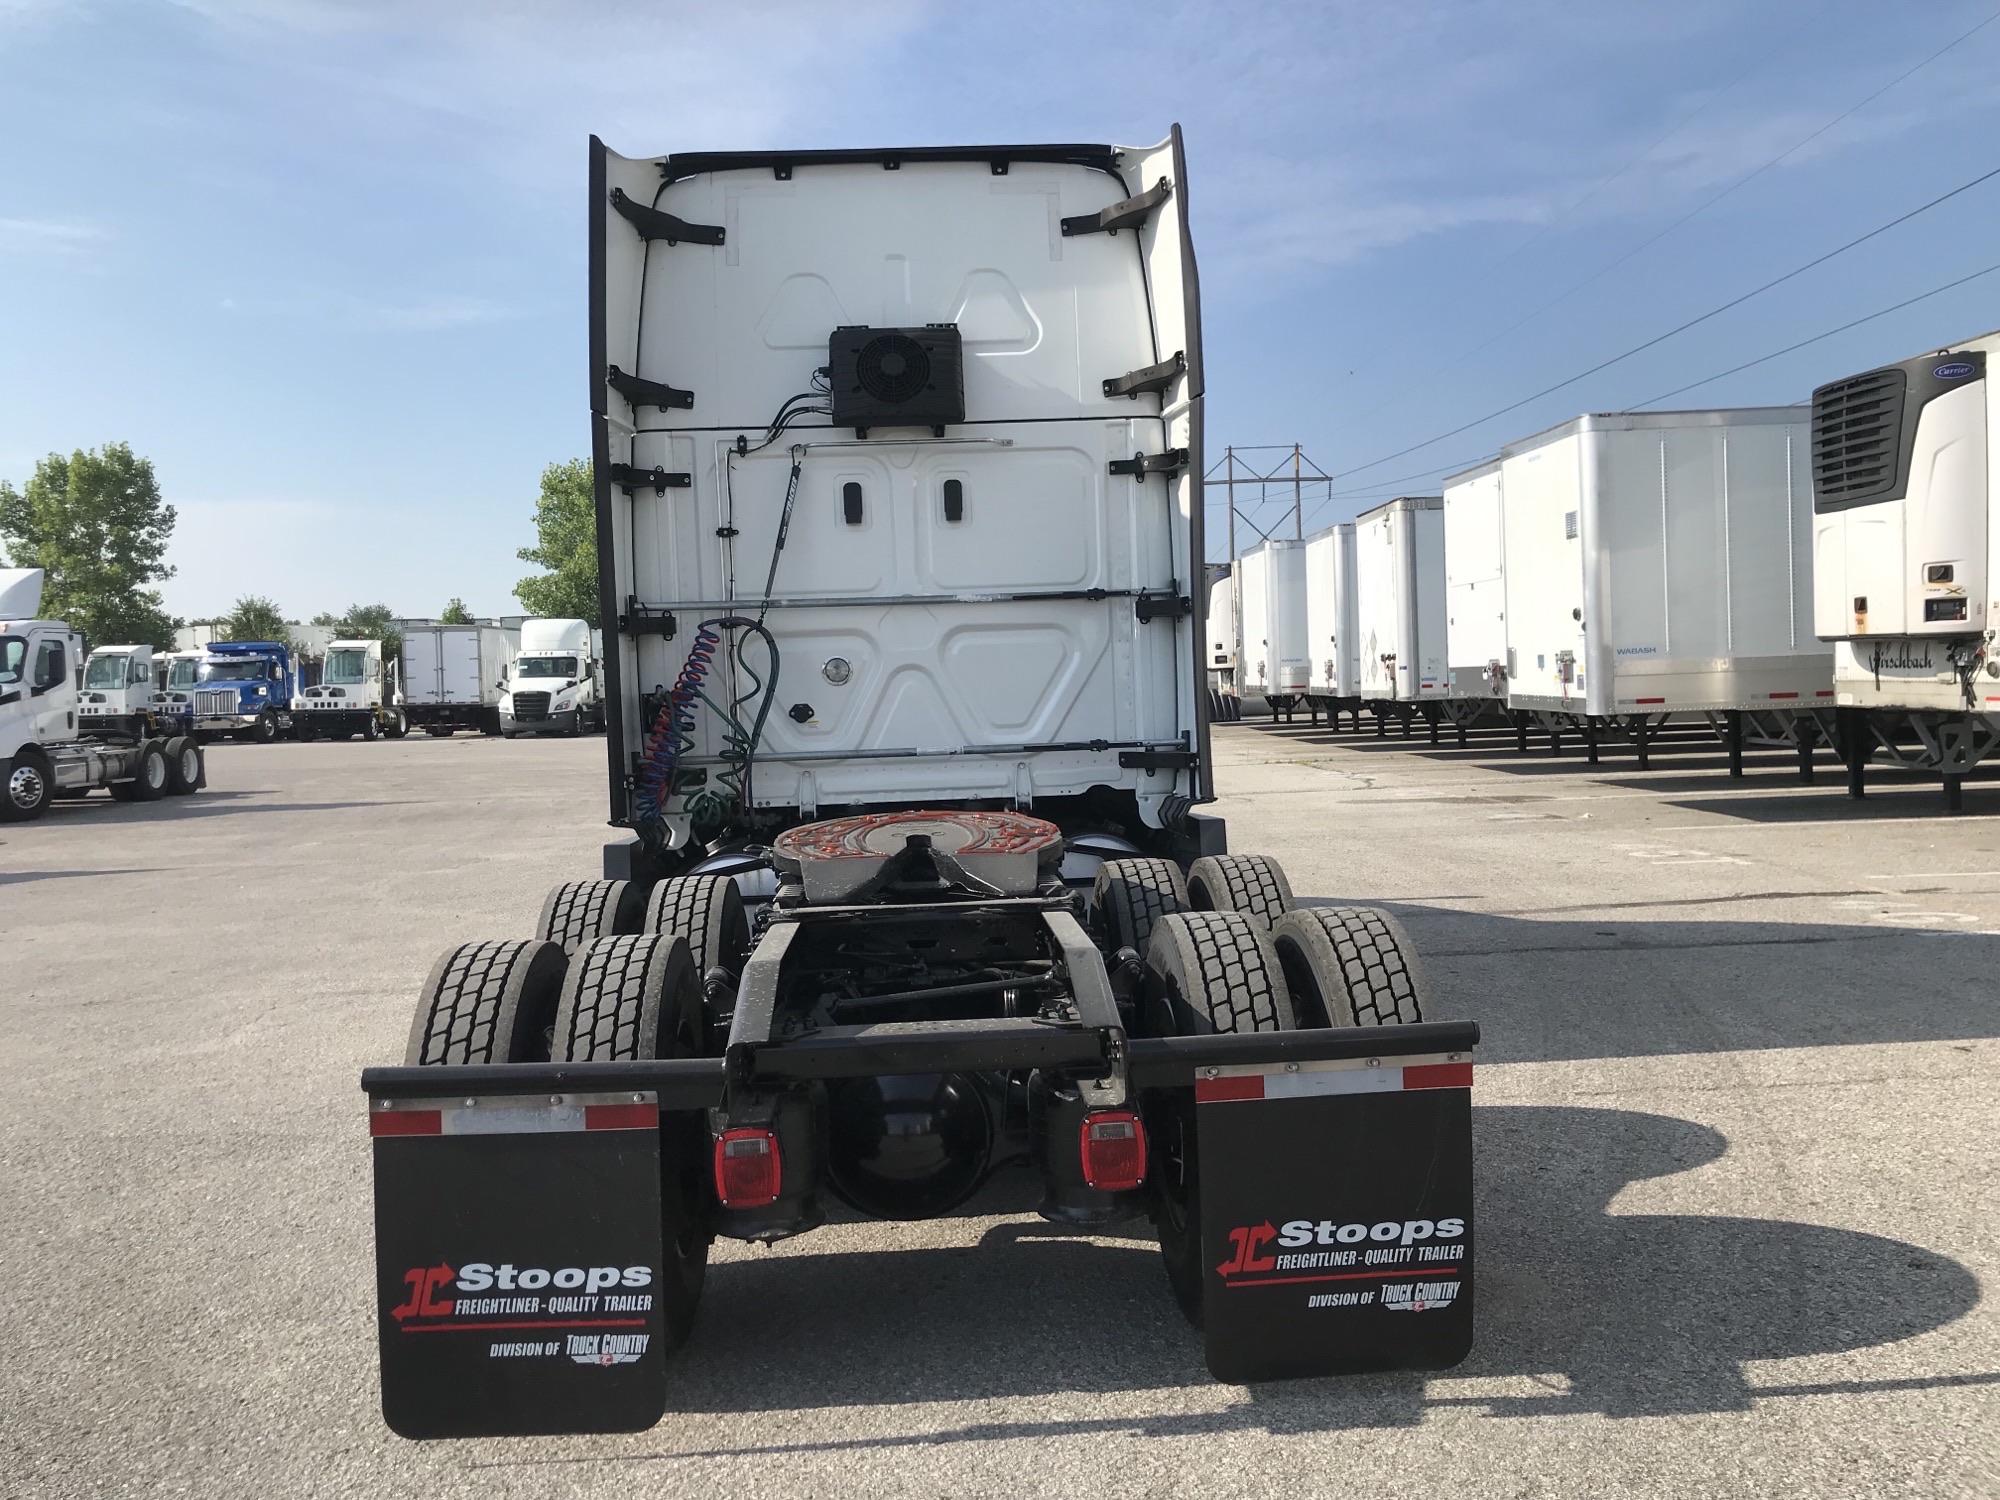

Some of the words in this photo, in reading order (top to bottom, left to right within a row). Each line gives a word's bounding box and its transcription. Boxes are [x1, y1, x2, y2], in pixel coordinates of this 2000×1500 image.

[1938, 366, 1970, 376] Carrier
[1616, 647, 1656, 655] WABASH
[1278, 1219, 1464, 1246] Stoops
[1365, 1248, 1413, 1265] QUALITY
[1419, 1245, 1464, 1261] TRAILER
[456, 1264, 652, 1293] Stoops
[549, 1296, 599, 1314] QUALITY
[605, 1295, 652, 1311] TRAILER
[1309, 1293, 1358, 1307] DIVISION
[1361, 1292, 1375, 1304] OF
[1381, 1284, 1413, 1303] TRUCK
[1415, 1282, 1460, 1300] COUNTRY
[490, 1343, 543, 1357] DIVISION
[545, 1342, 560, 1355] OF
[566, 1335, 601, 1356] TRUCK
[602, 1334, 650, 1354] COUNTRY
